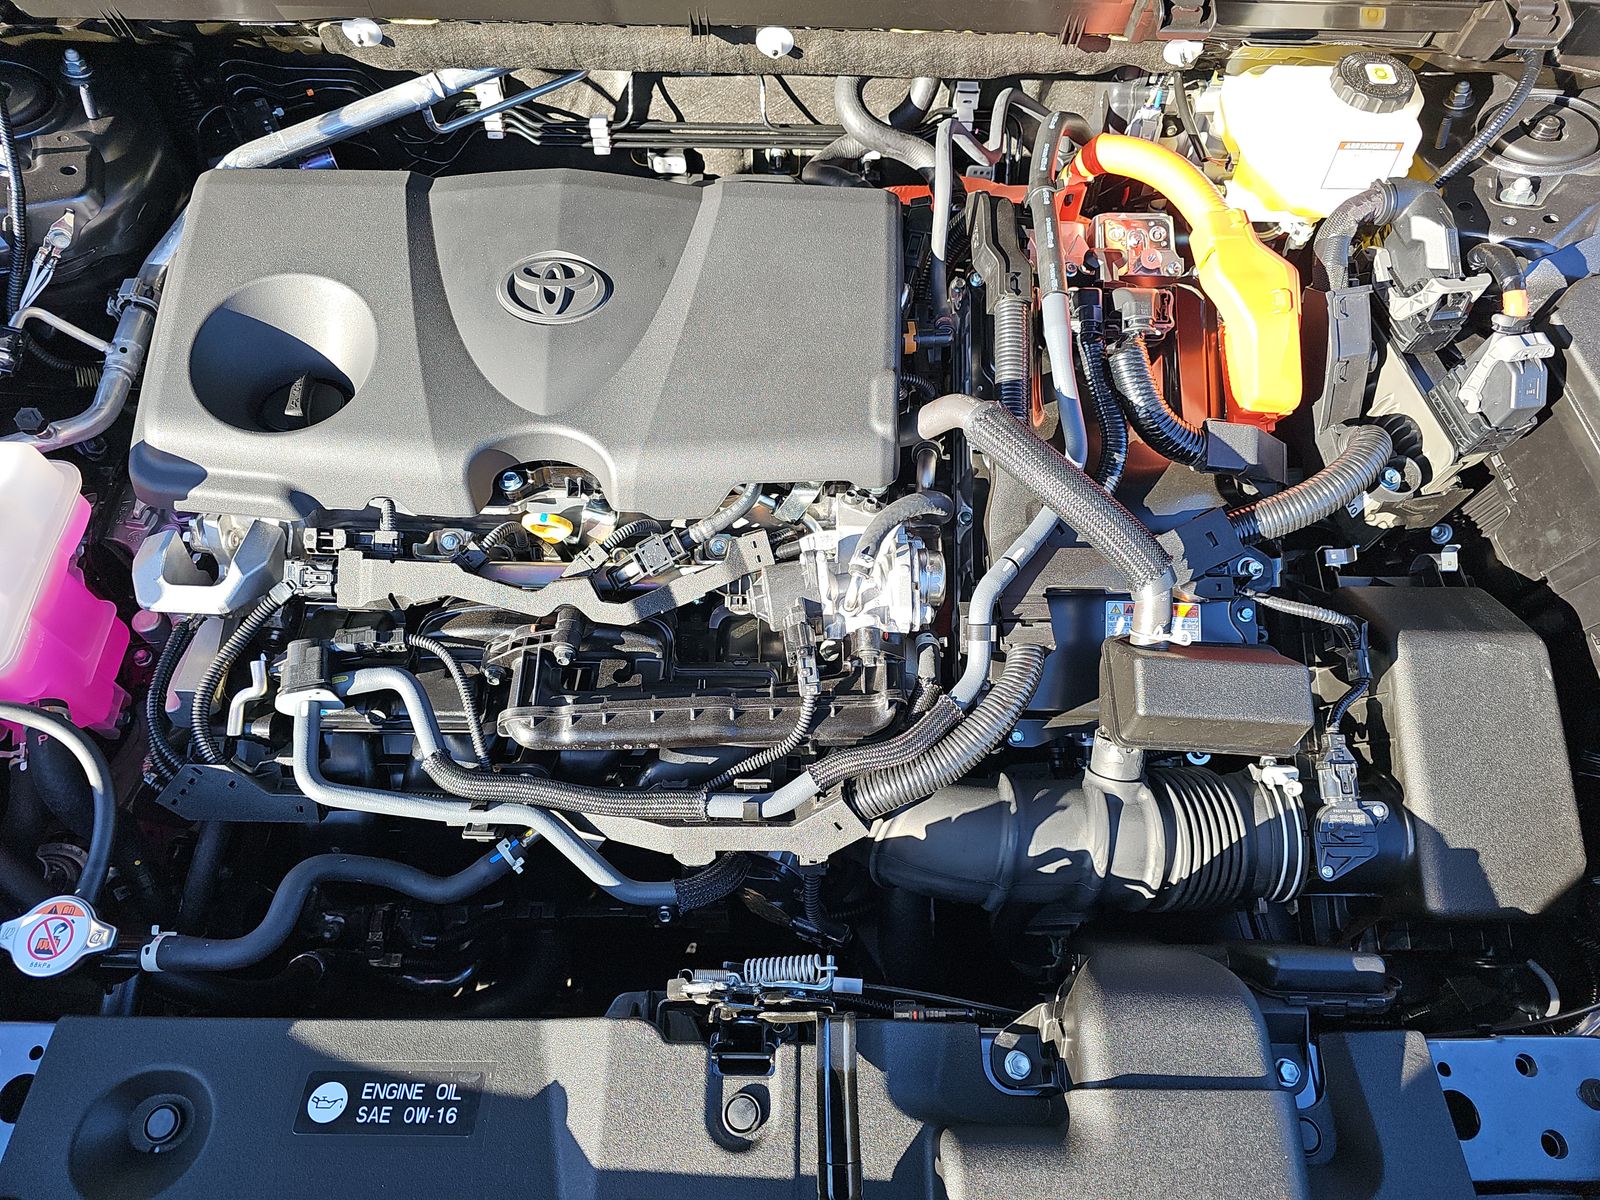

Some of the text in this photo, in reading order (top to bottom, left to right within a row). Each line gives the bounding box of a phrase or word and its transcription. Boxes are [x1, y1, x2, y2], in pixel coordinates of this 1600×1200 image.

[361, 1083, 462, 1100] ENGINE OIL
[355, 1106, 458, 1124] SAE 0W-16
